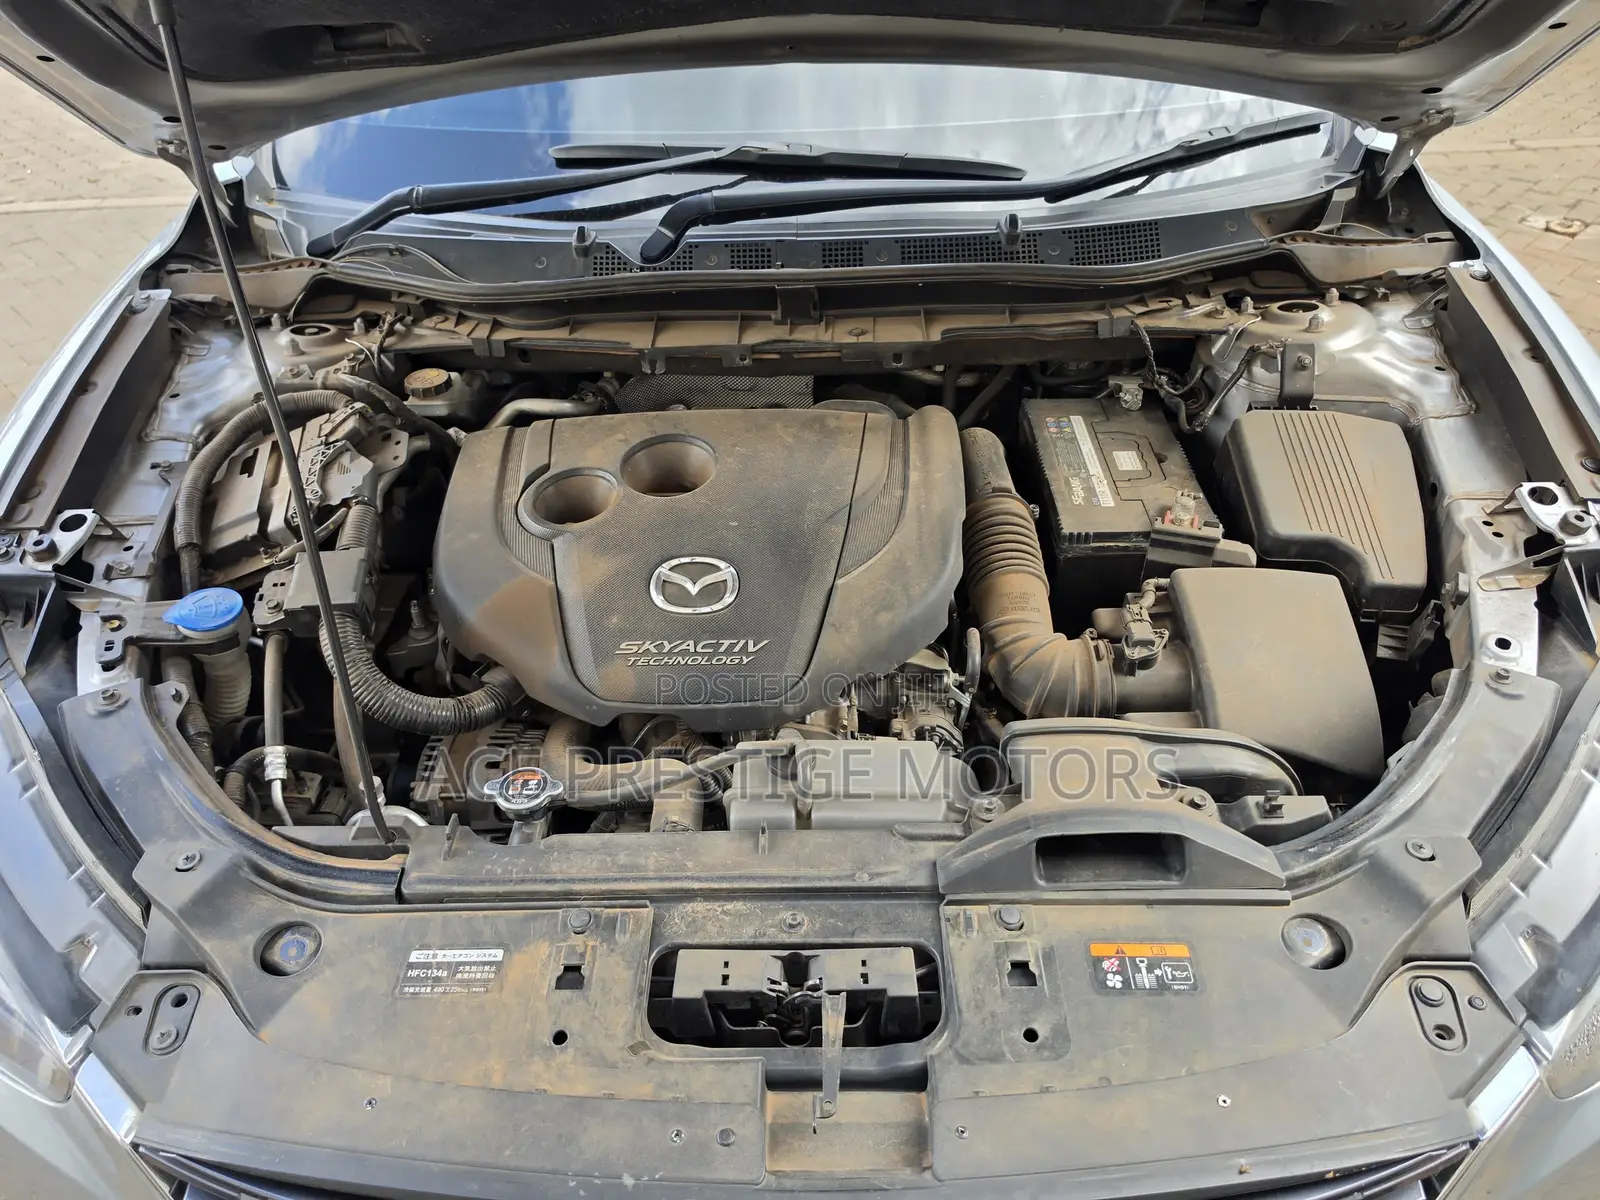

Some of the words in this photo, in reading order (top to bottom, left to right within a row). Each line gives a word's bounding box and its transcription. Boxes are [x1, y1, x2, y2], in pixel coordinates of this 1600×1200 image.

[614, 639, 771, 655] SKYACTIV
[626, 655, 756, 667] TECHNOLOGY
[407, 968, 448, 978] HFC134a
